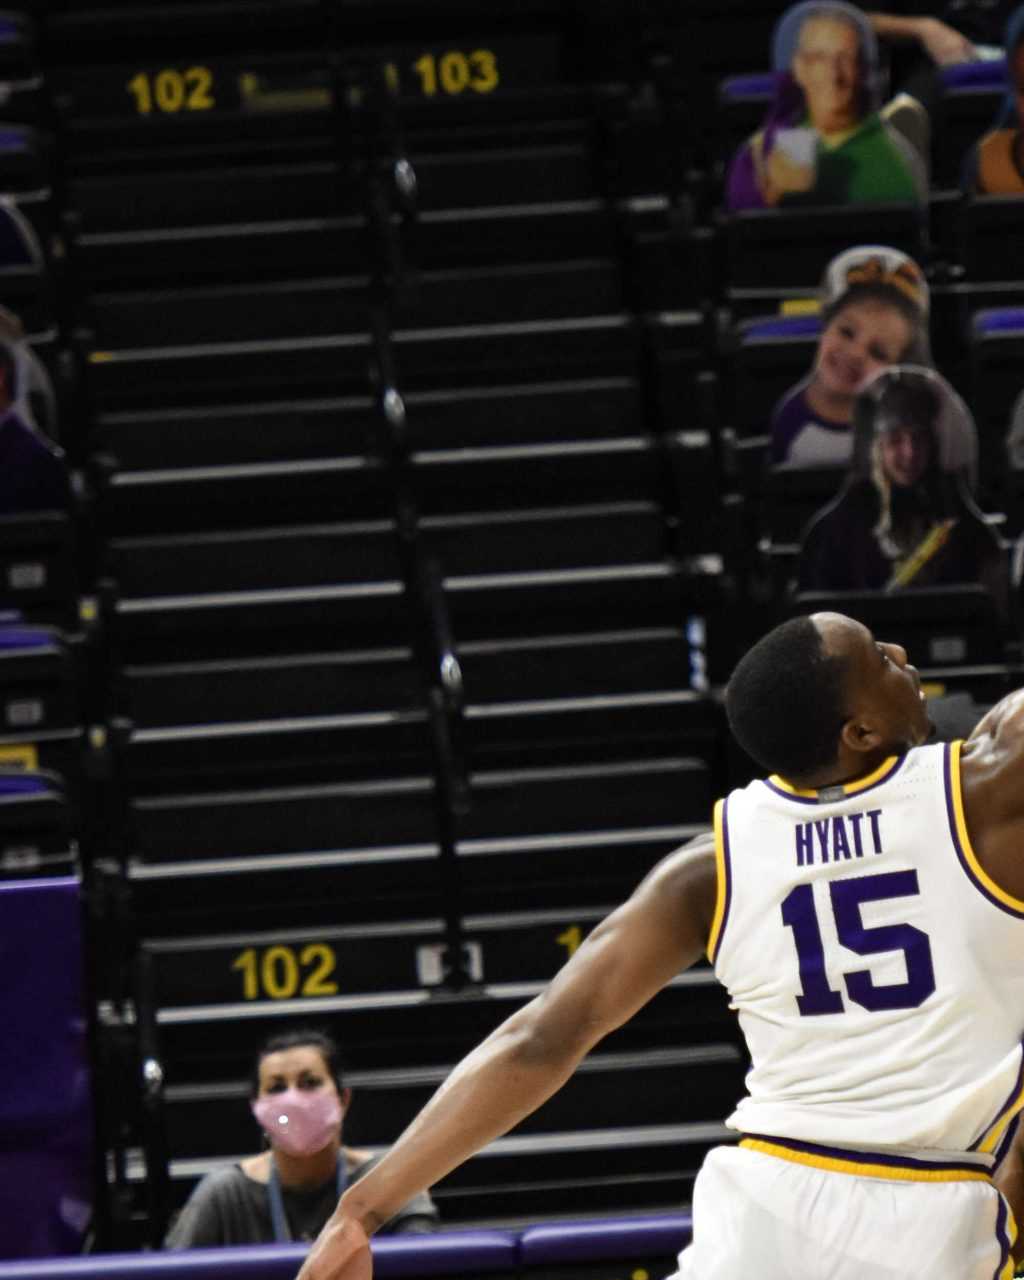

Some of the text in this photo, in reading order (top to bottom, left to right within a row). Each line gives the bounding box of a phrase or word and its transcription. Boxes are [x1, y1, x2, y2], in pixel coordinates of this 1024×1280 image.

[128, 66, 215, 114] 102
[414, 50, 499, 97] 103
[795, 809, 883, 867] HYATT
[232, 943, 338, 999] 102
[780, 869, 936, 1017] 15
